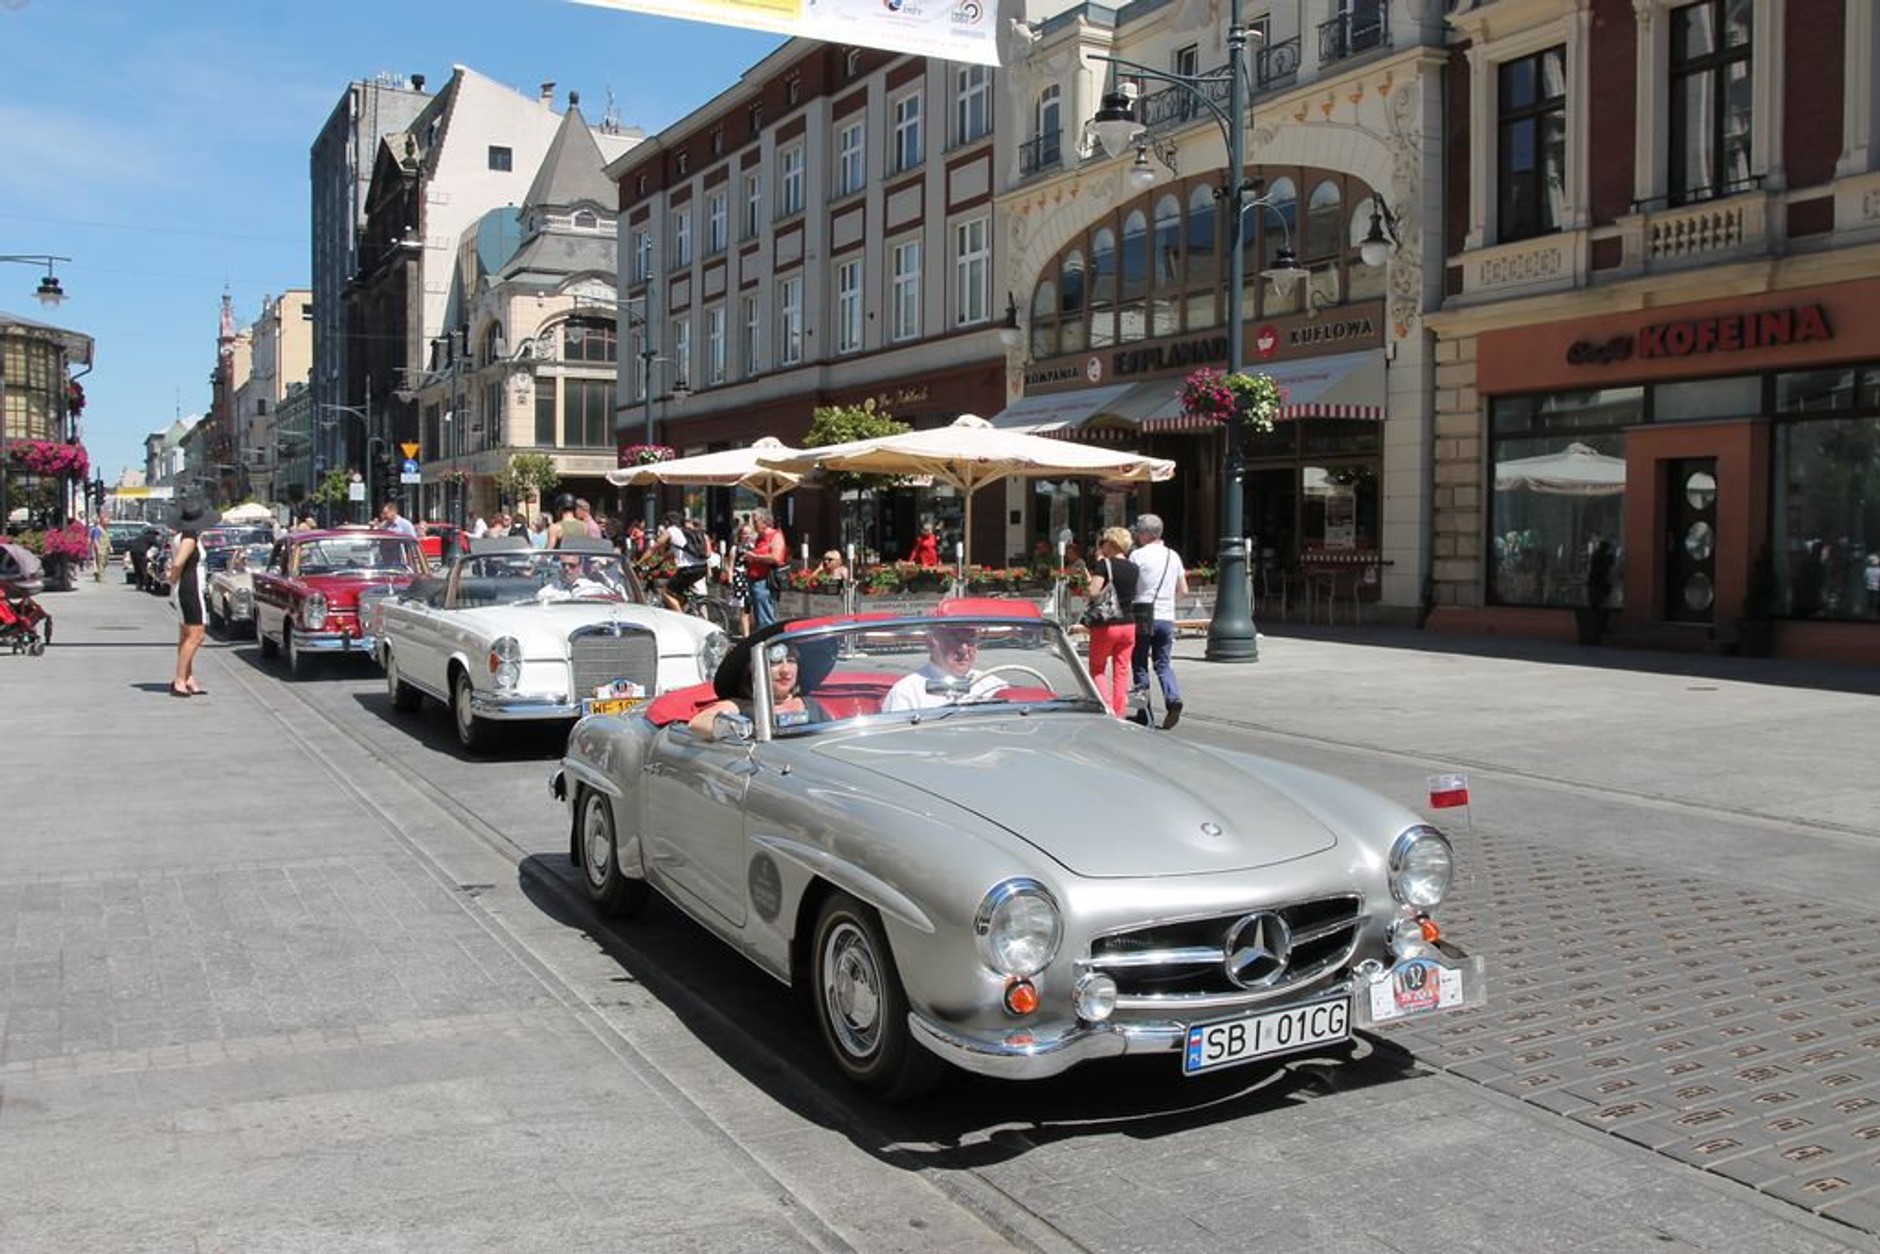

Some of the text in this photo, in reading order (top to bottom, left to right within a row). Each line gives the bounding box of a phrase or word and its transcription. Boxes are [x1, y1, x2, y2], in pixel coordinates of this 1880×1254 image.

[1291, 320, 1373, 345] KUFLOWA
[1640, 305, 1833, 359] KOFEINA
[1113, 337, 1229, 374] ESPLANAD
[1207, 1004, 1344, 1060] SBI 01CG
